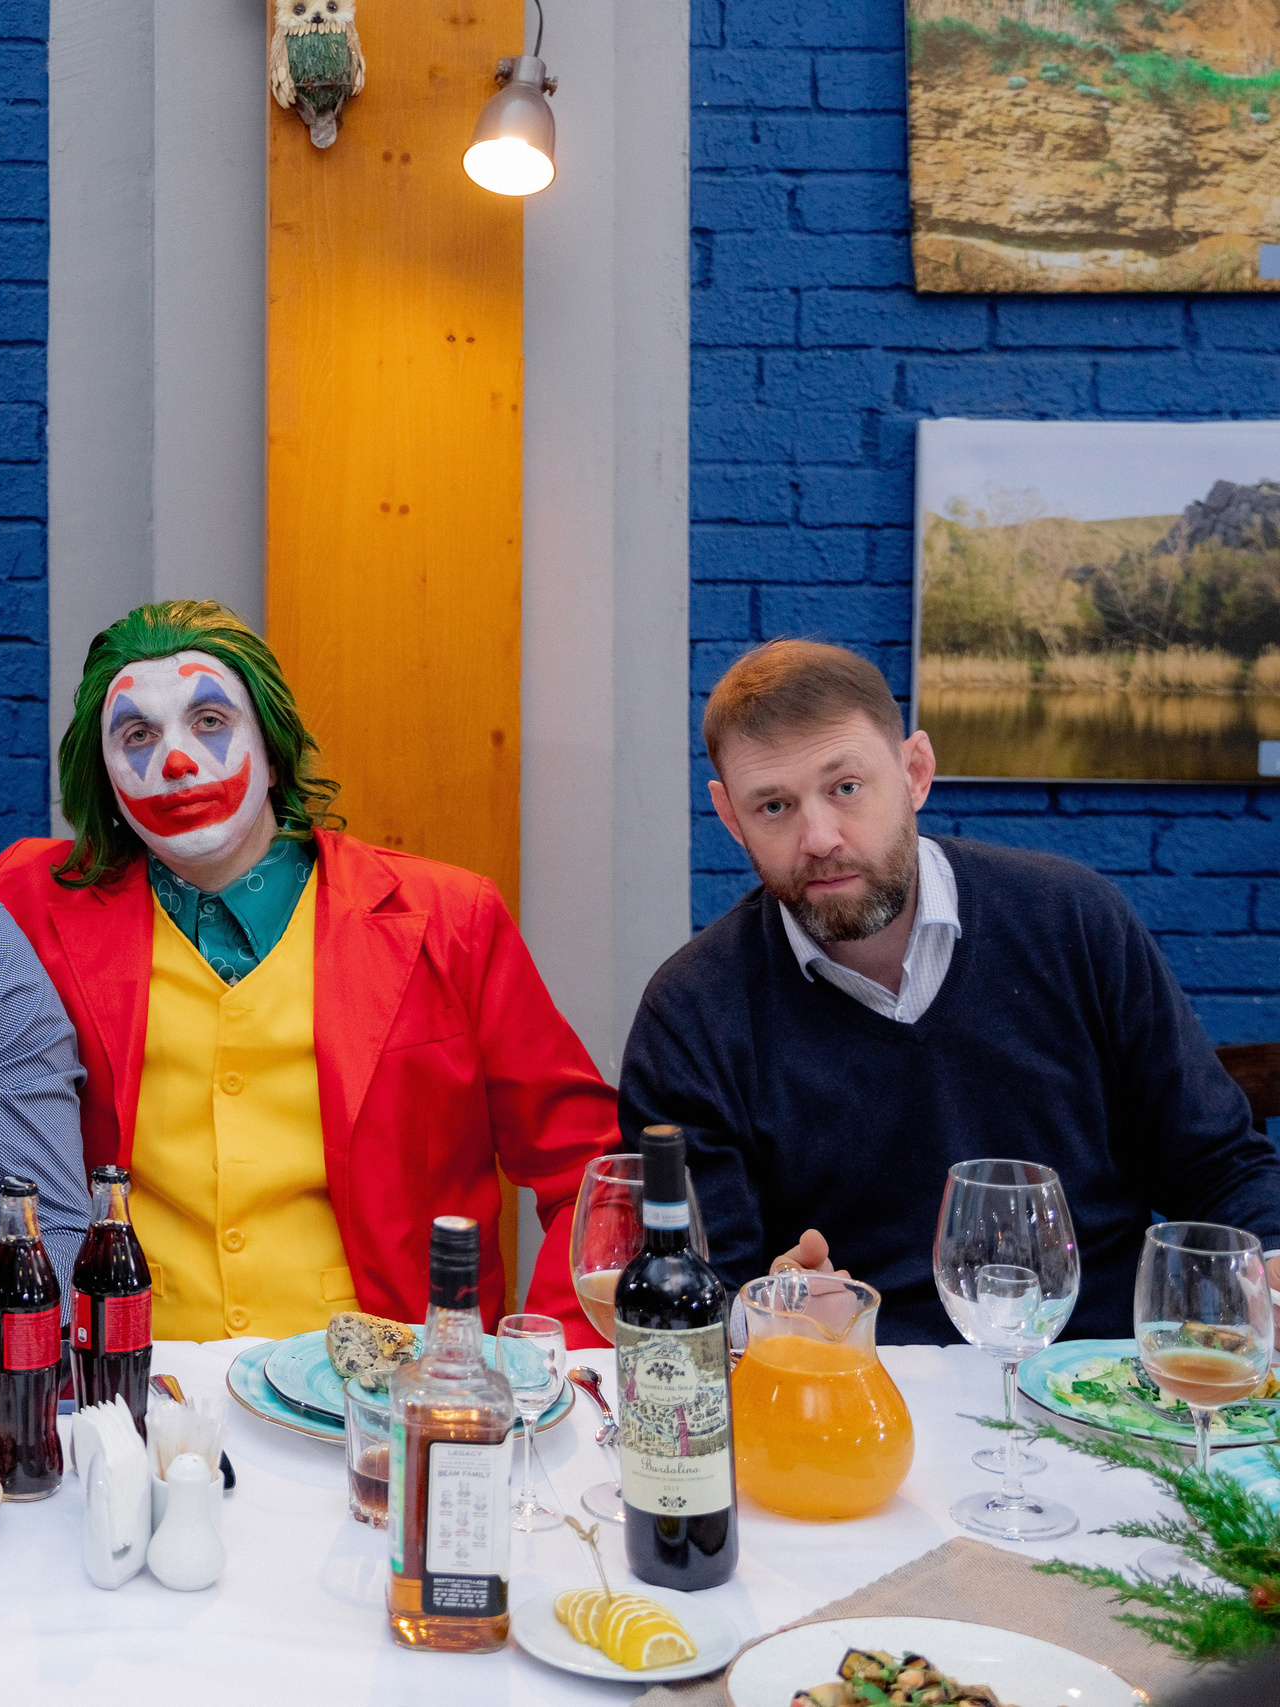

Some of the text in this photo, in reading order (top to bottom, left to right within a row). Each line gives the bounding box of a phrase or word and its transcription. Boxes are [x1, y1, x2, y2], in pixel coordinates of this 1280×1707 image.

[640, 1456, 701, 1474] Bardolino
[437, 1469, 491, 1479] BEAM FAMILY
